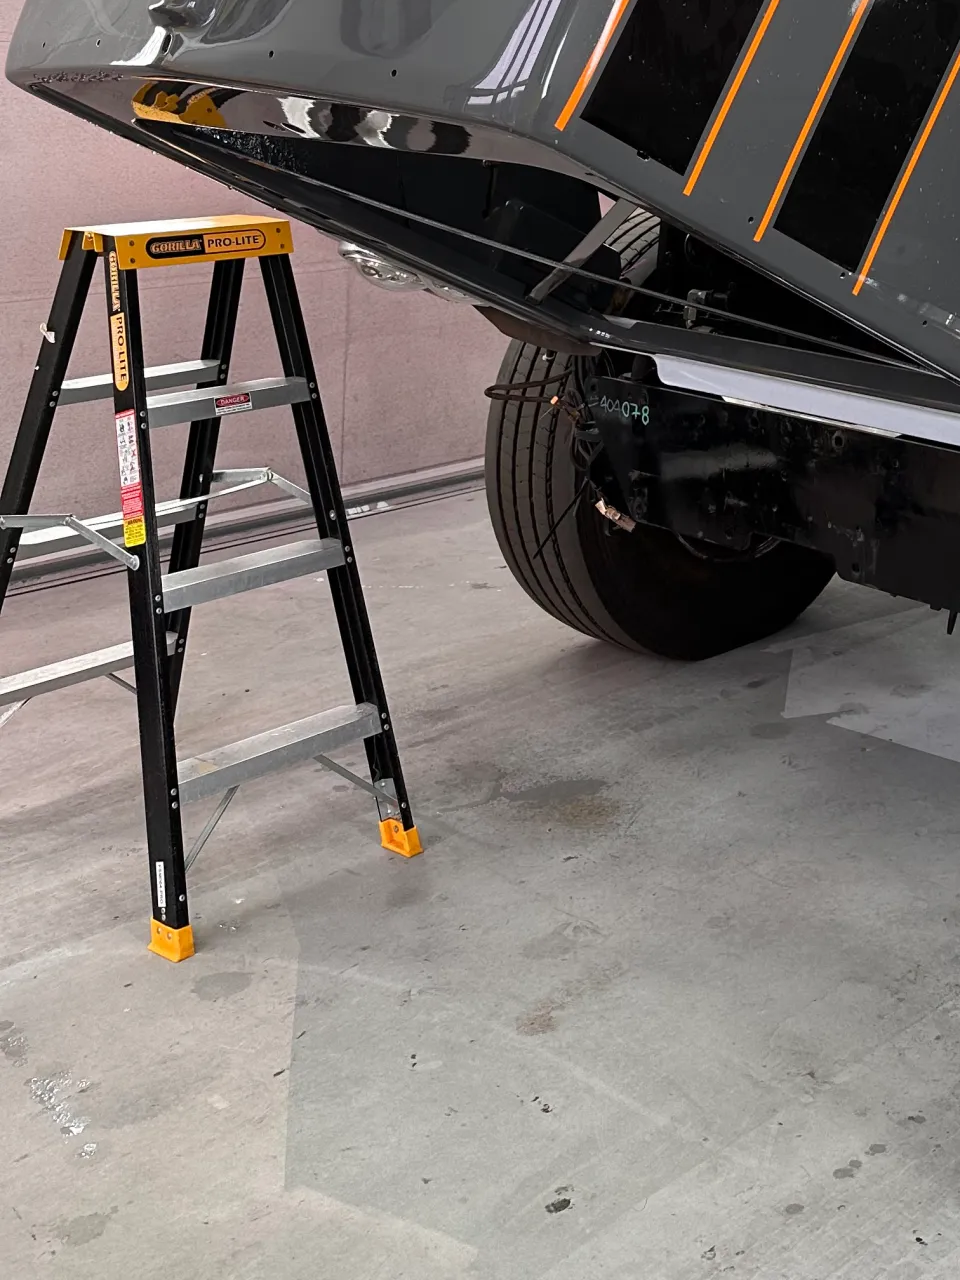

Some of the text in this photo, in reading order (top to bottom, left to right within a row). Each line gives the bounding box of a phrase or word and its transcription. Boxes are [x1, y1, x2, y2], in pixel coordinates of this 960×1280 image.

[150, 234, 261, 254] GORILLA PRO-LITE
[108, 251, 128, 383] GORILLA PRO-LITE
[219, 395, 246, 406] DANGER
[600, 395, 650, 426] 404078
